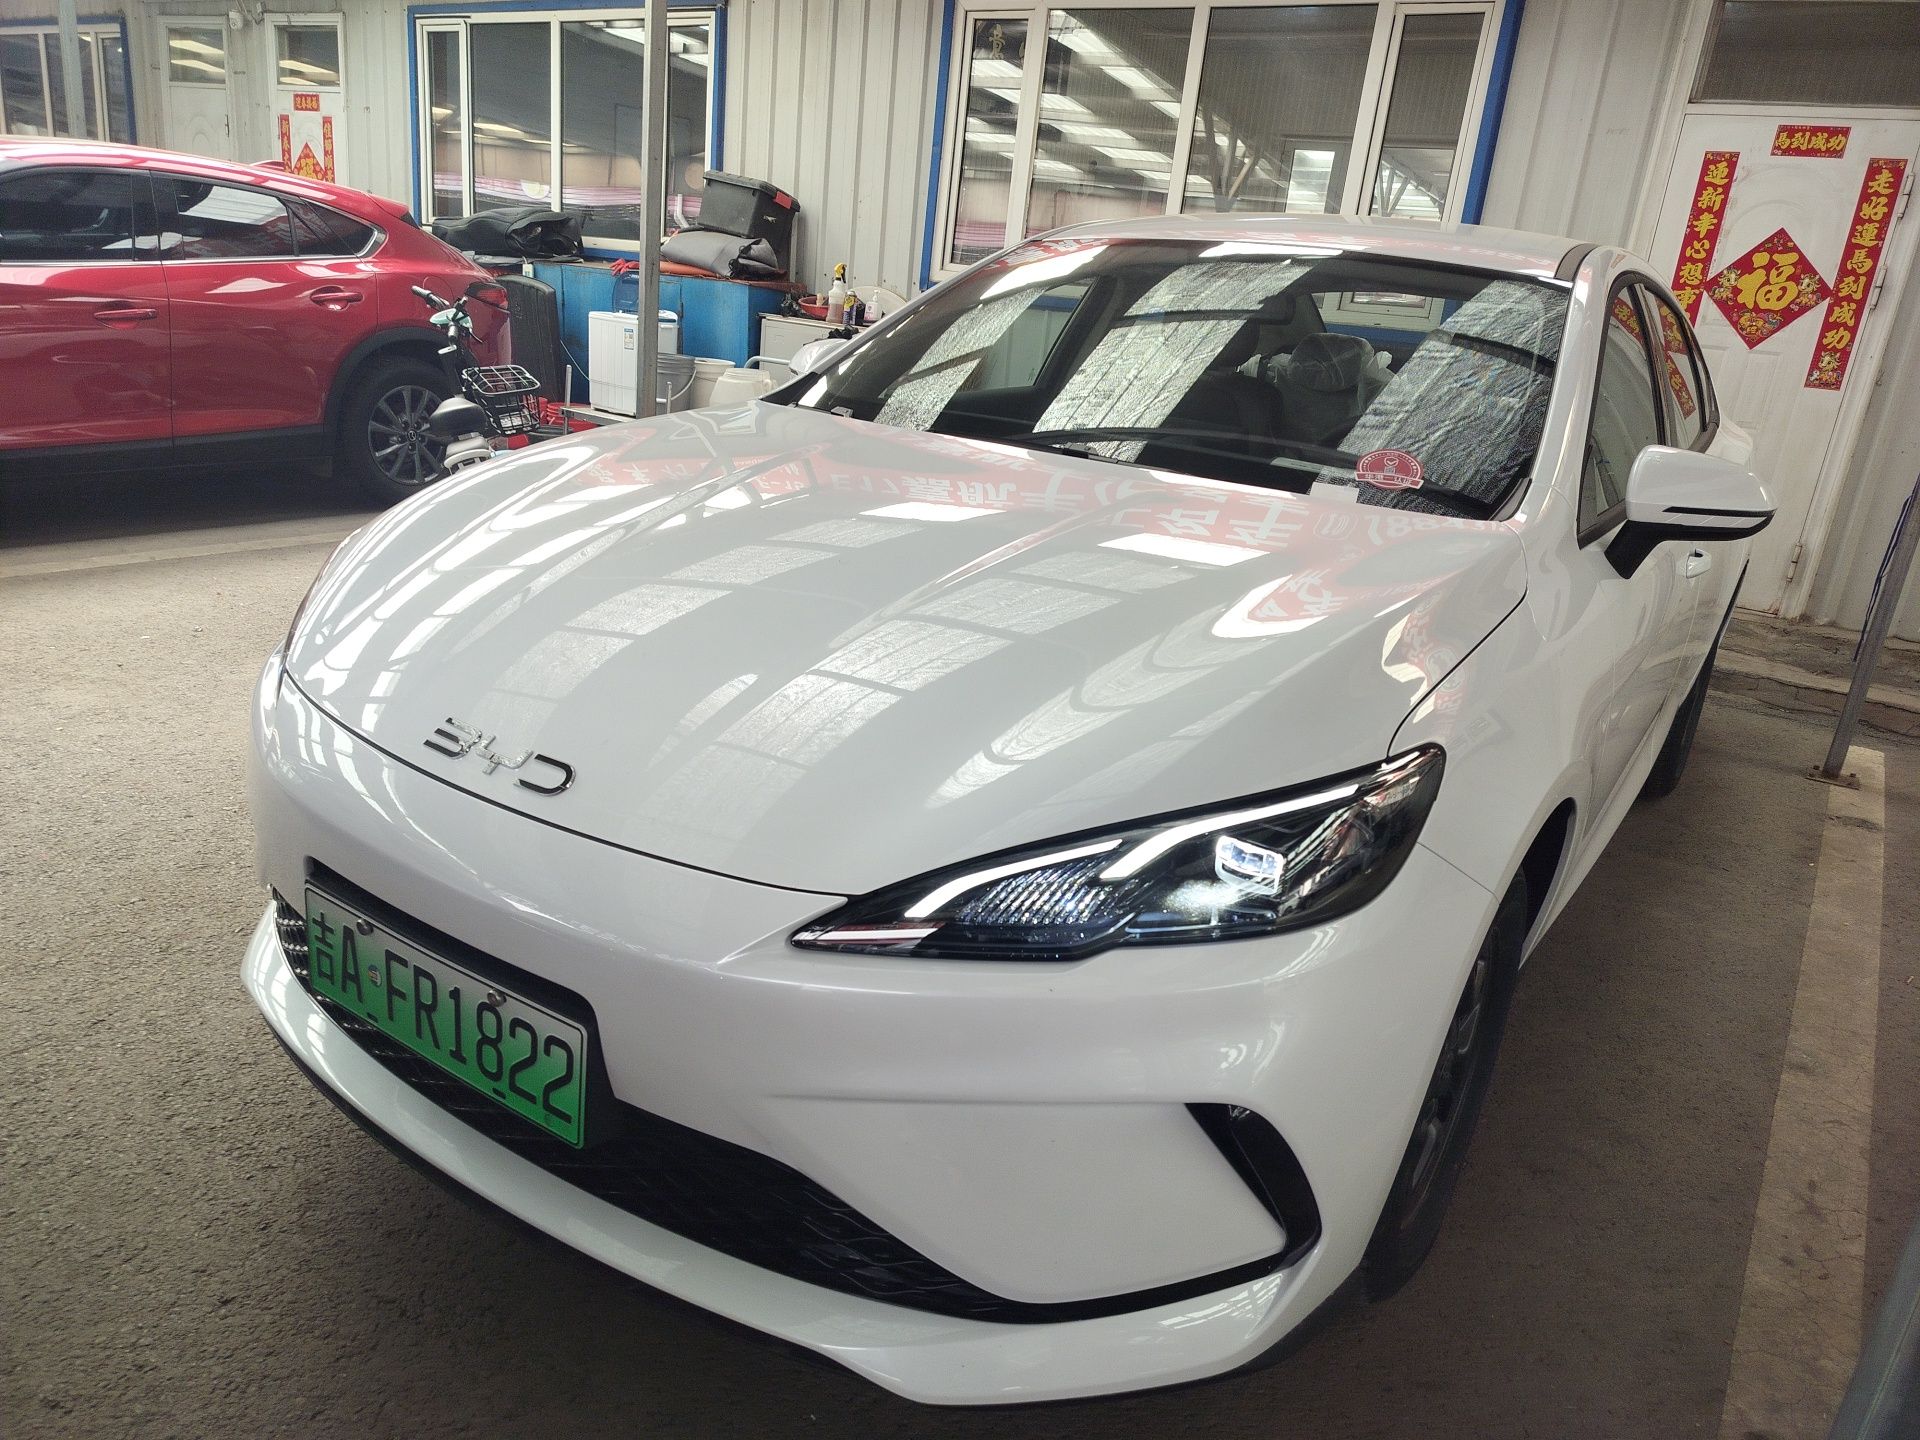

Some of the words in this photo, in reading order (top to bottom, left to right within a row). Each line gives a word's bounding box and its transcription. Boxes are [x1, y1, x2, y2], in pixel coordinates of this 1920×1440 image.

[1775, 131, 1847, 151] 馬到成功
[1736, 251, 1801, 311] 福
[1822, 168, 1896, 350] 走好運馬到成功
[422, 717, 576, 797] BYD
